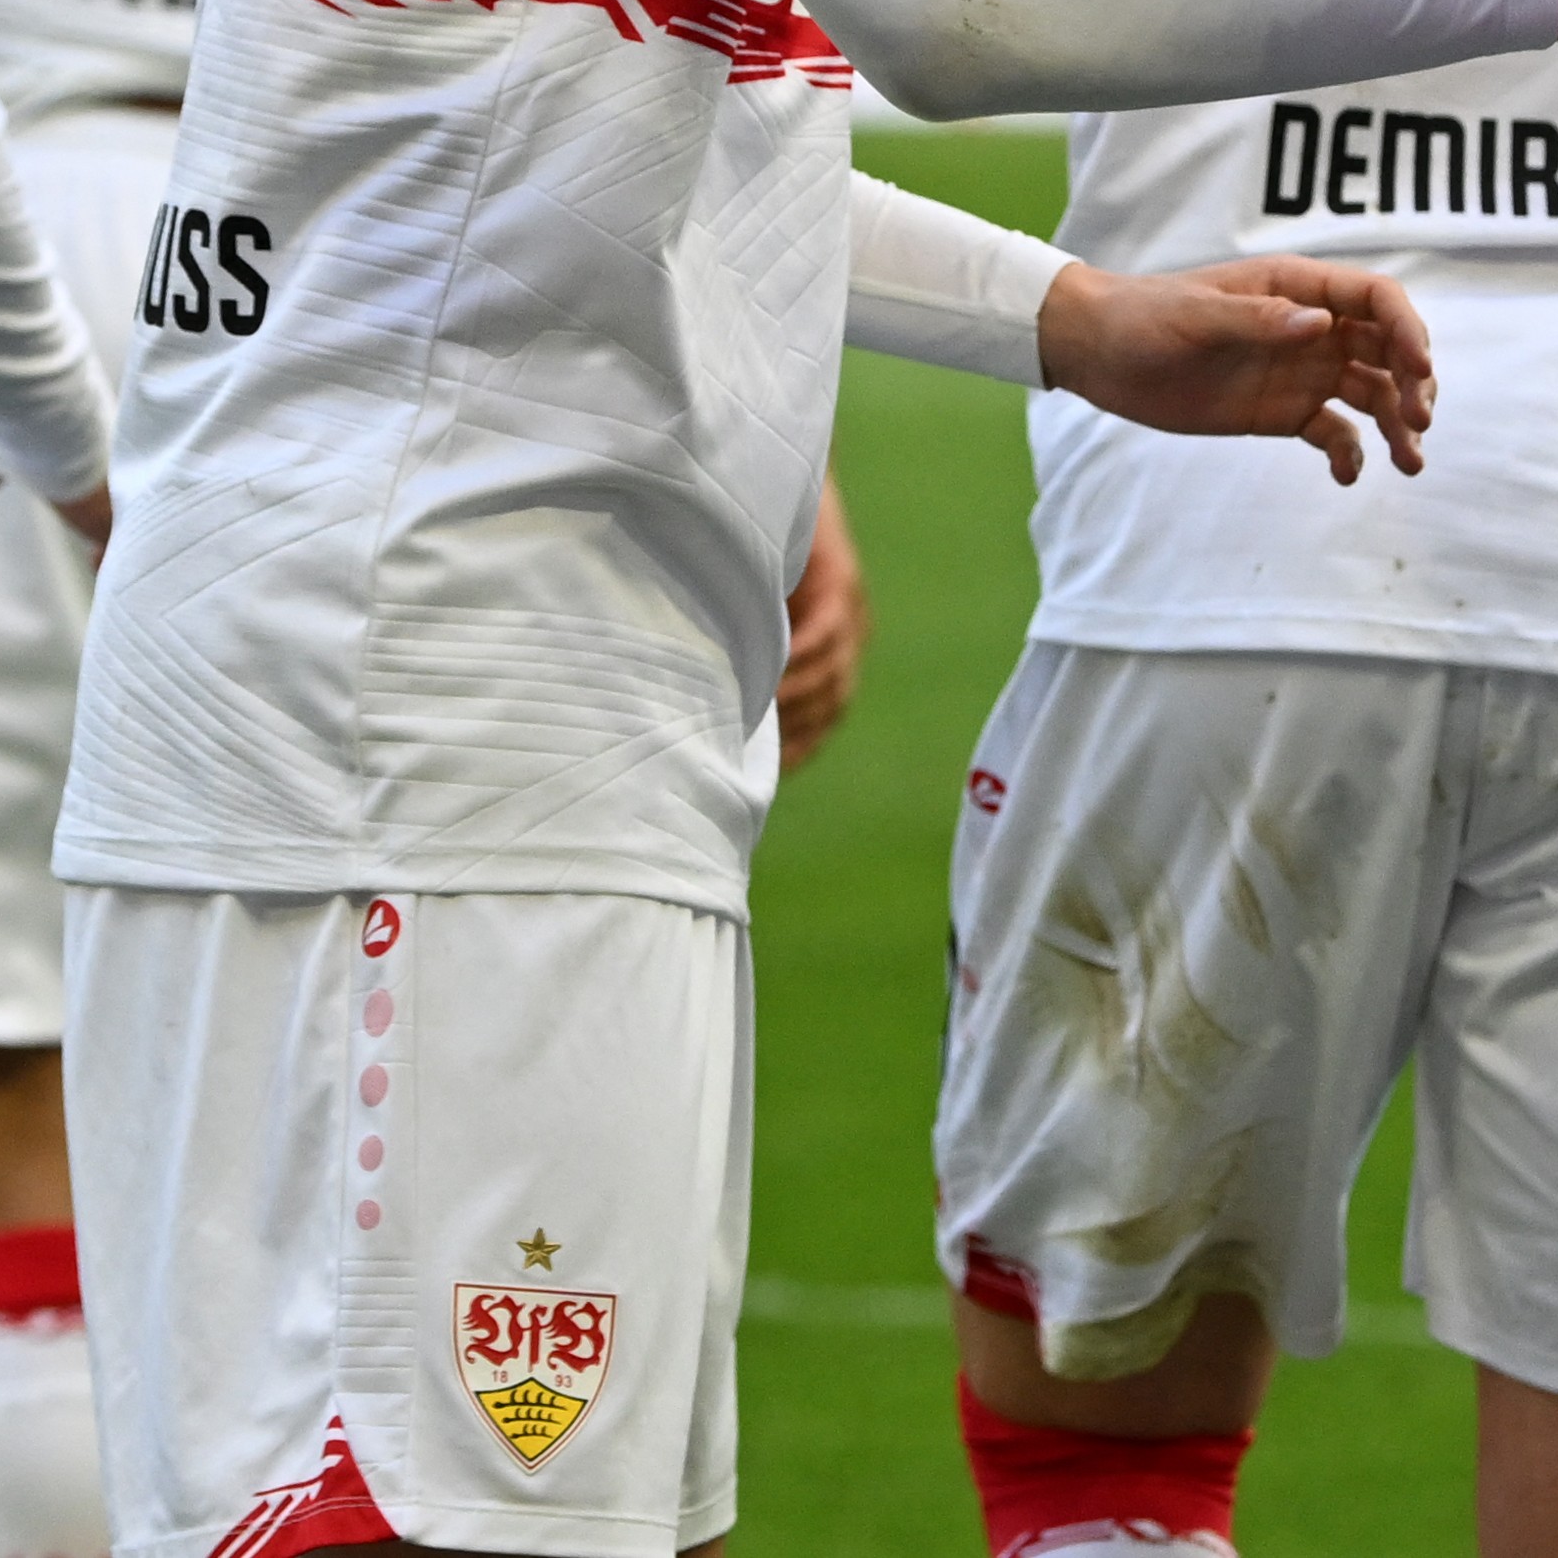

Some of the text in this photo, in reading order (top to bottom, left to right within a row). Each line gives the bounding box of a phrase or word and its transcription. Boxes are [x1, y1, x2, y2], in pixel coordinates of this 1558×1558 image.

[134, 203, 272, 337] USS
[462, 1293, 608, 1374] VfB
[493, 1371, 573, 1388] 18 93
